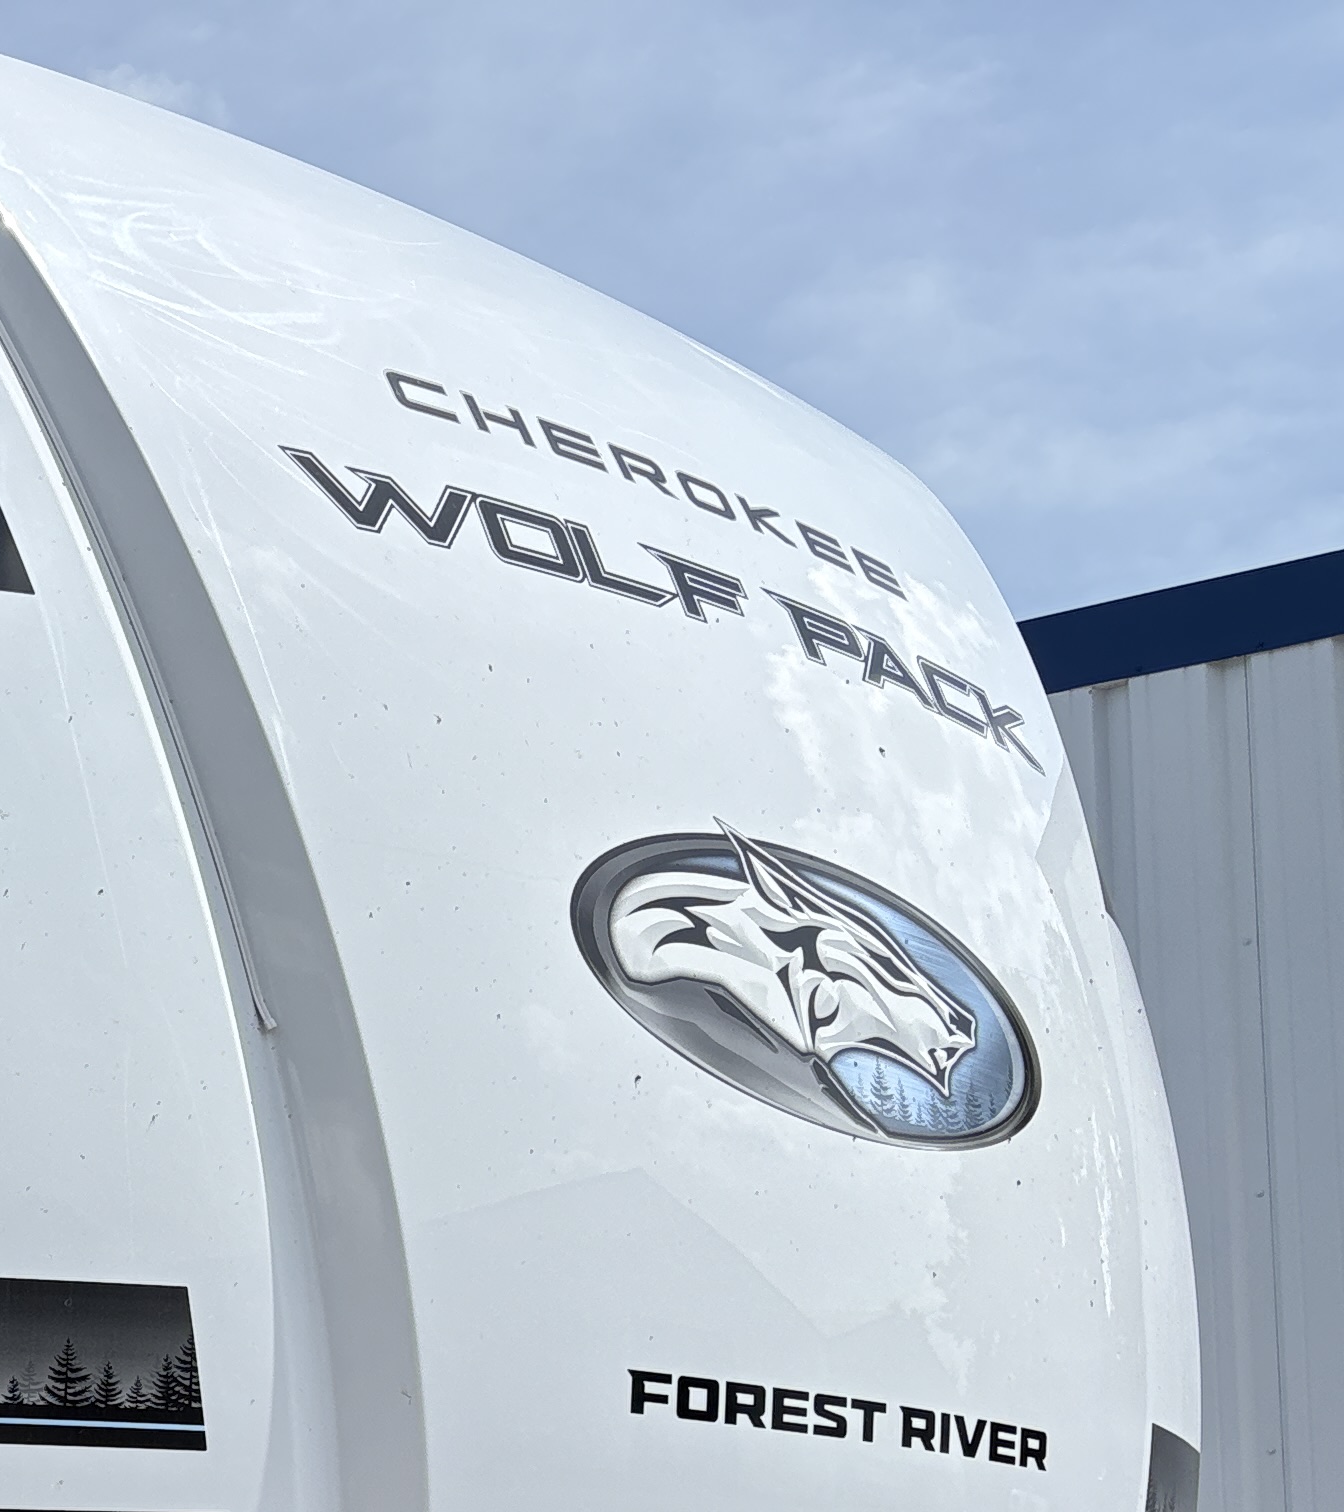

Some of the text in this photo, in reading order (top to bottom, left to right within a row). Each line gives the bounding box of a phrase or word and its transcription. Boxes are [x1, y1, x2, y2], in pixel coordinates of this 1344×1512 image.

[384, 369, 909, 601] CHEROKEE
[278, 444, 1046, 778] WOLF PACK
[627, 1368, 1048, 1472] FOREST RIVER
